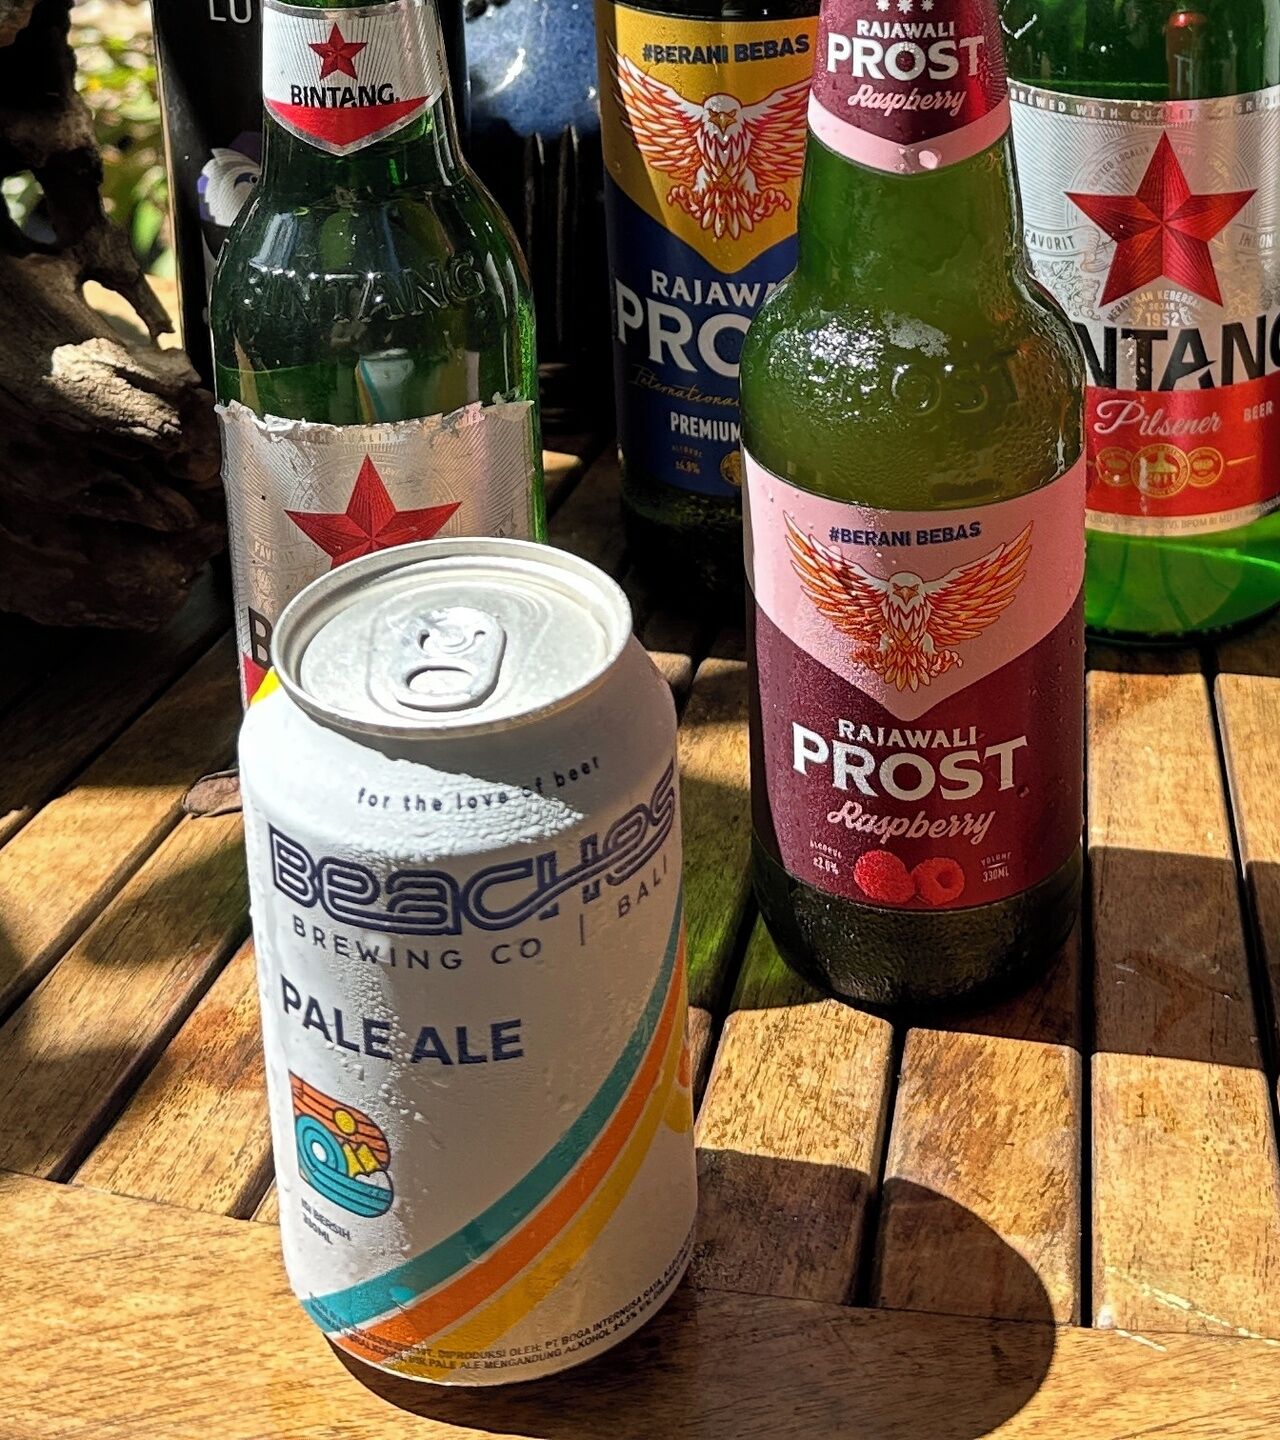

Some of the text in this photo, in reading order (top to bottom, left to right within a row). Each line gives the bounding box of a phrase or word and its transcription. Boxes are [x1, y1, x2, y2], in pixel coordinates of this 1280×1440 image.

[856, 19, 955, 39] RAJAWALI
[642, 34, 810, 64] #BERANI BEBAS
[826, 32, 985, 81] PROST
[290, 83, 396, 108] BINTANG
[847, 84, 967, 117] Raspberry
[1024, 229, 1075, 250] FAVORIT
[670, 411, 742, 442] PREMIUM
[1093, 397, 1274, 438] Pilsener BEER
[828, 521, 981, 547] #BERANI BEBAS
[838, 718, 978, 749] RAJAWALI
[791, 721, 1028, 802] PROST
[357, 756, 600, 812] for the love of beer
[826, 799, 996, 846] Raspberry
[982, 866, 1010, 883] 330ML
[293, 855, 668, 970] BREWING CO BALI
[280, 974, 524, 1066] PALE ALE
